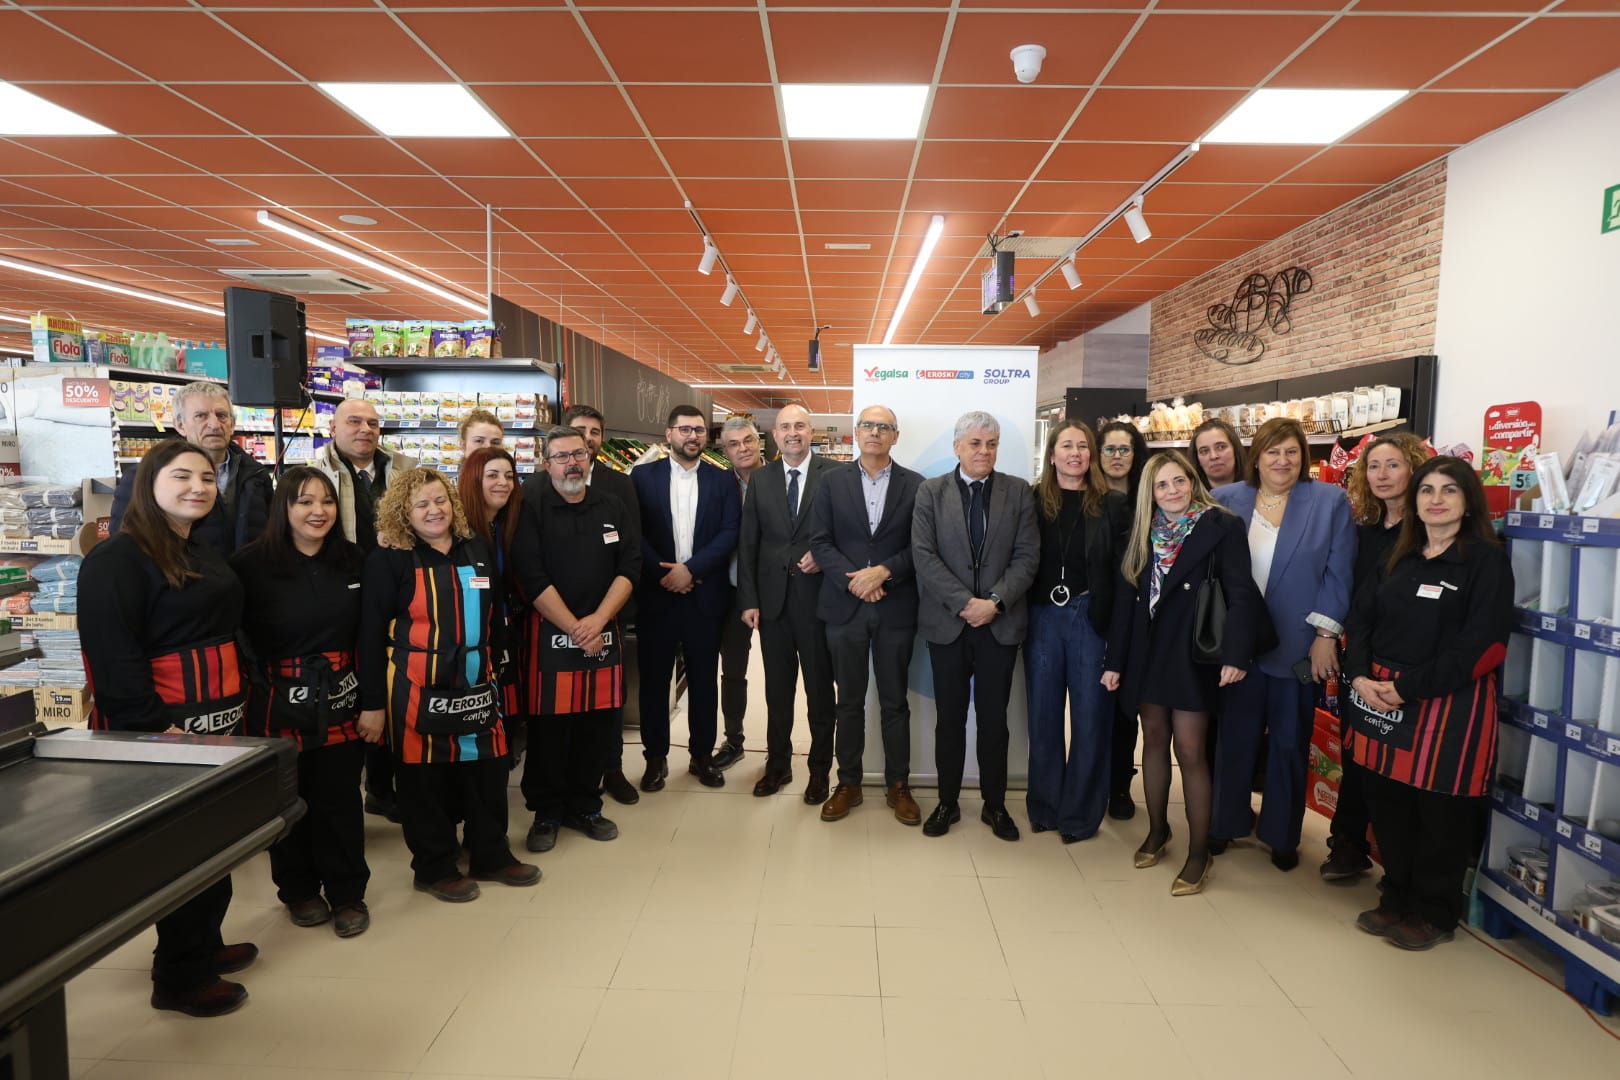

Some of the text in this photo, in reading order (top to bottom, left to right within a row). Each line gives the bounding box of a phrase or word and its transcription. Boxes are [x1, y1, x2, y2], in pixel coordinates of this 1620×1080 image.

[53, 339, 80, 356] Flota
[927, 371, 955, 379] EROSKI
[984, 368, 1031, 378] SOLTRA
[65, 385, 99, 397] 50%
[452, 693, 491, 711] EROSKI
[1357, 695, 1399, 720] EKI
[43, 707, 72, 718] MIRO
[462, 709, 490, 725] contigo
[1364, 715, 1394, 735] contigo
